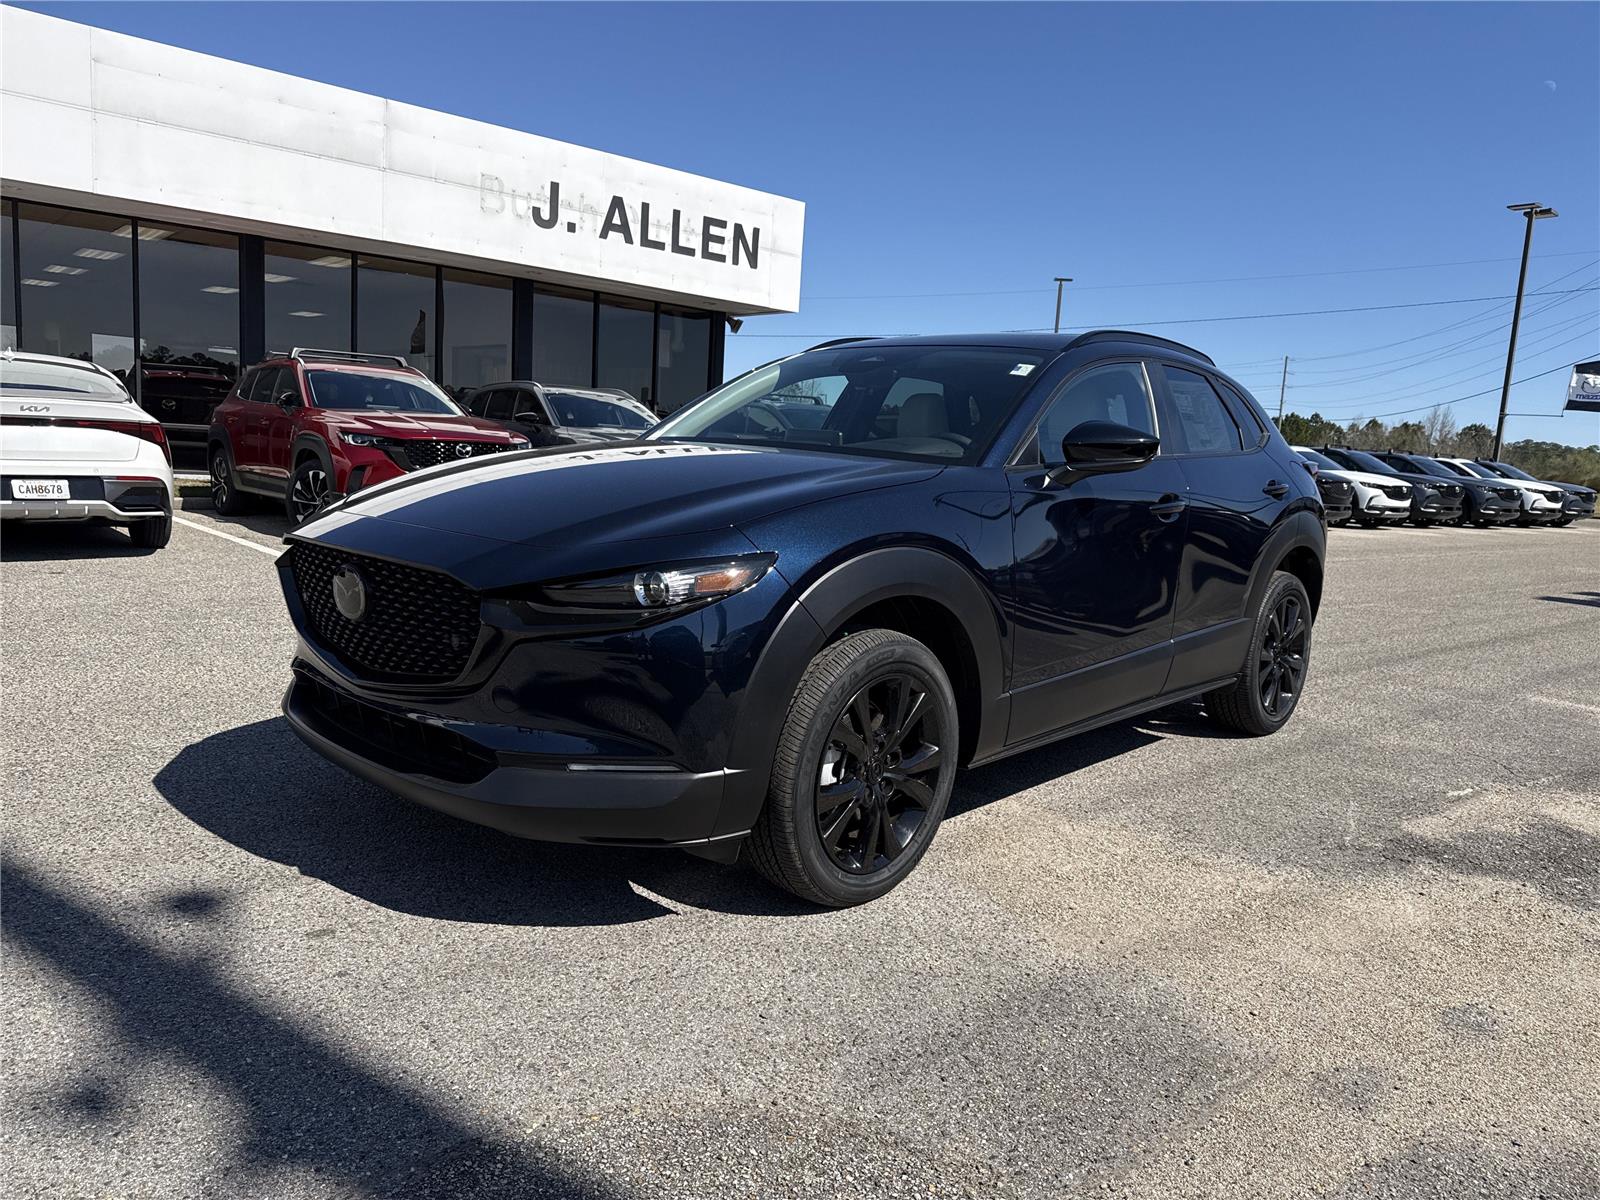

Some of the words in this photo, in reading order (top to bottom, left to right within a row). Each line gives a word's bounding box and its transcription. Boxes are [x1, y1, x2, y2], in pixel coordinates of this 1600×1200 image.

[531, 180, 577, 234] J.
[598, 194, 761, 270] ALLEN
[18, 484, 63, 494] CAH8678
